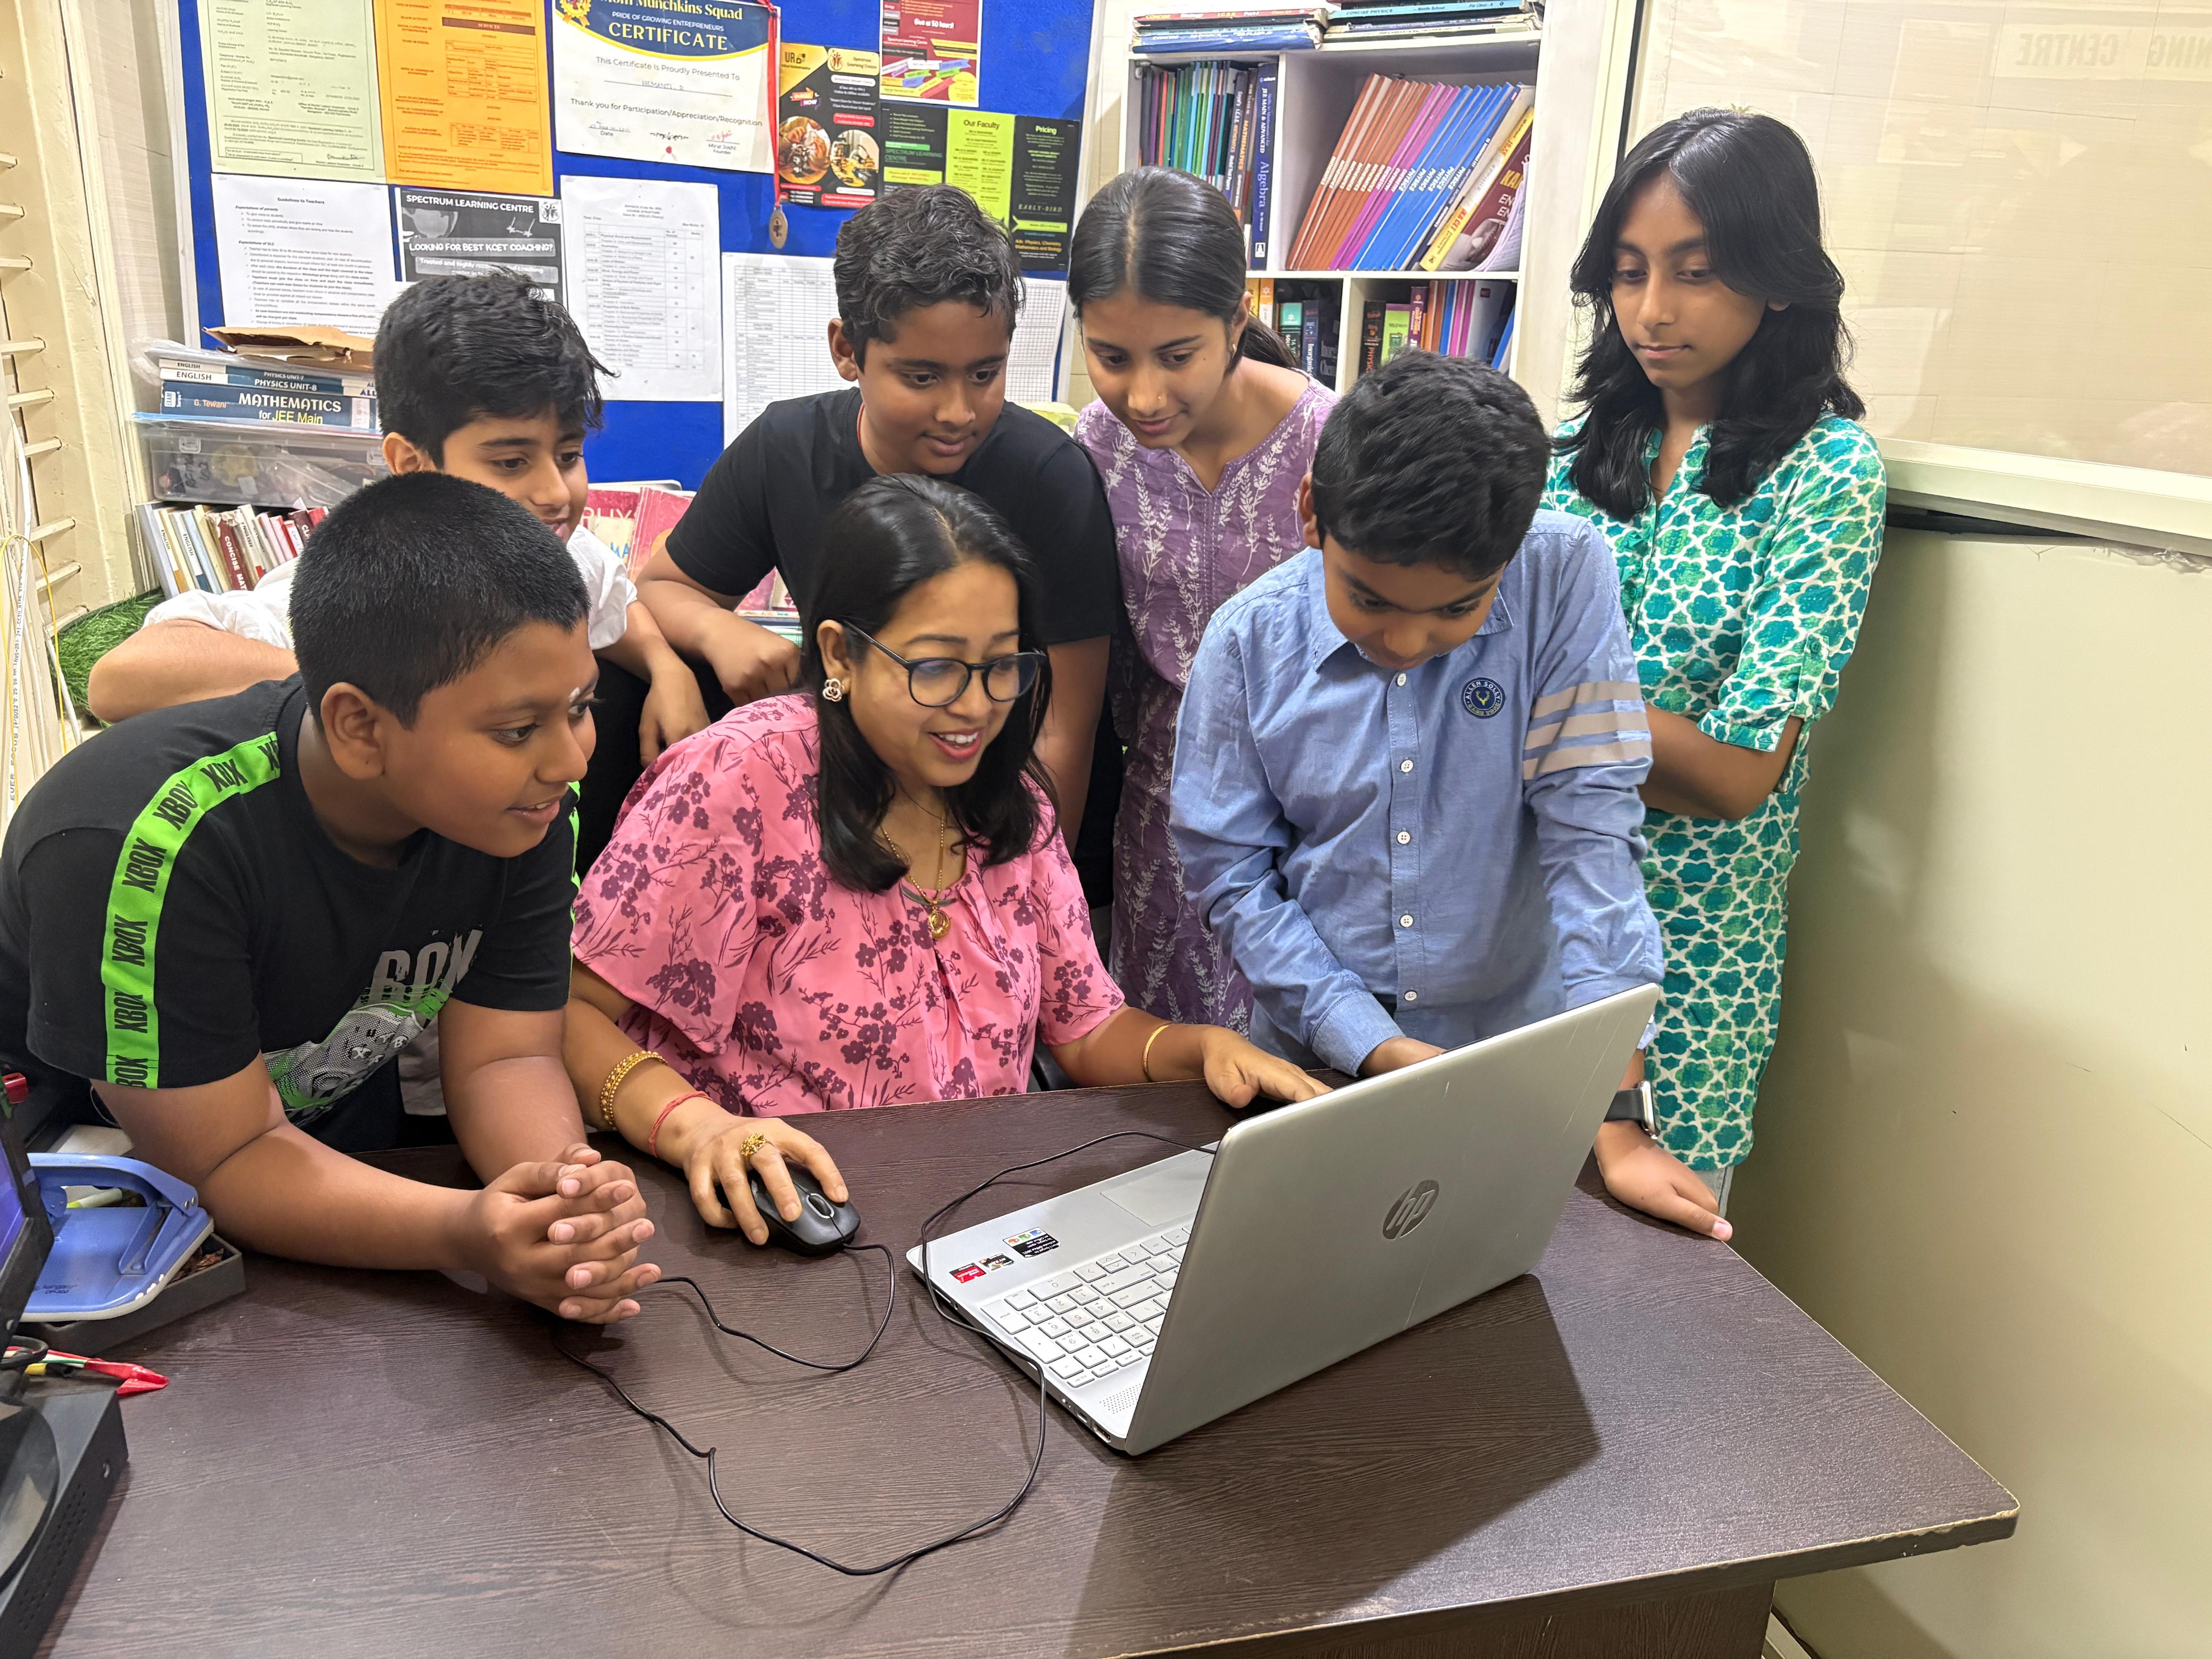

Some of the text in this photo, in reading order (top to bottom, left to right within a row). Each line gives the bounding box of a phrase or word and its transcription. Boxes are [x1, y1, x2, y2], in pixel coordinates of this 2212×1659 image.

[612, 11, 631, 20] PRIDE
[642, 14, 672, 24] GROWING
[673, 19, 724, 31] ENTREPRENEURS
[636, 0, 742, 20] Munchkins Squad
[608, 22, 728, 51] CERTIFICATE
[596, 56, 612, 65] This
[613, 59, 652, 70] Certificate
[653, 62, 660, 71] Is
[661, 64, 690, 76] Proudly
[692, 69, 729, 80] Presented
[1235, 91, 1244, 107] Goyal's
[571, 98, 594, 107] Thank
[596, 102, 609, 111] you
[623, 105, 763, 127] Participation/Appreciation/Recognition
[977, 121, 1000, 130] Faculty
[1035, 125, 1057, 135] Pricing
[1237, 120, 1249, 171] MATHEMATICS
[1257, 161, 1270, 208] Algebra
[1376, 166, 1392, 190] CHEMISTRY
[1384, 167, 1401, 192] CHEMISTRY
[1391, 169, 1407, 193] CHEMISTRY
[1398, 168, 1417, 192] PHYSICS
[1409, 168, 1427, 192] PHYSICS
[1418, 168, 1436, 192] PHYSICS
[1427, 168, 1445, 192] PHYSICS
[1436, 166, 1455, 190] PHYSICS
[1448, 166, 1467, 190] PHYSICS
[406, 195, 534, 213] SPECTRUM LEARNING CENTRE
[1451, 220, 1461, 232] CET
[409, 242, 554, 252] LOOKING FOR BEST KCET COACHING?
[177, 371, 212, 381] ENGLISH
[254, 378, 288, 389] PHYSICS
[290, 382, 317, 391] UNIT-8
[203, 399, 228, 409] Tewani
[238, 392, 341, 413] MATHEMATICS
[258, 410, 323, 425] for JEE Main
[161, 530, 171, 550] ENGLISH
[183, 533, 194, 556] ENGLISH
[224, 535, 240, 572] CONCISE
[1465, 681, 1501, 700] ALLEN SOLLY
[121, 837, 167, 894] XBOX
[112, 914, 148, 967] XBOX
[113, 988, 148, 1034] XBOX
[1382, 1179, 1440, 1240] hp
